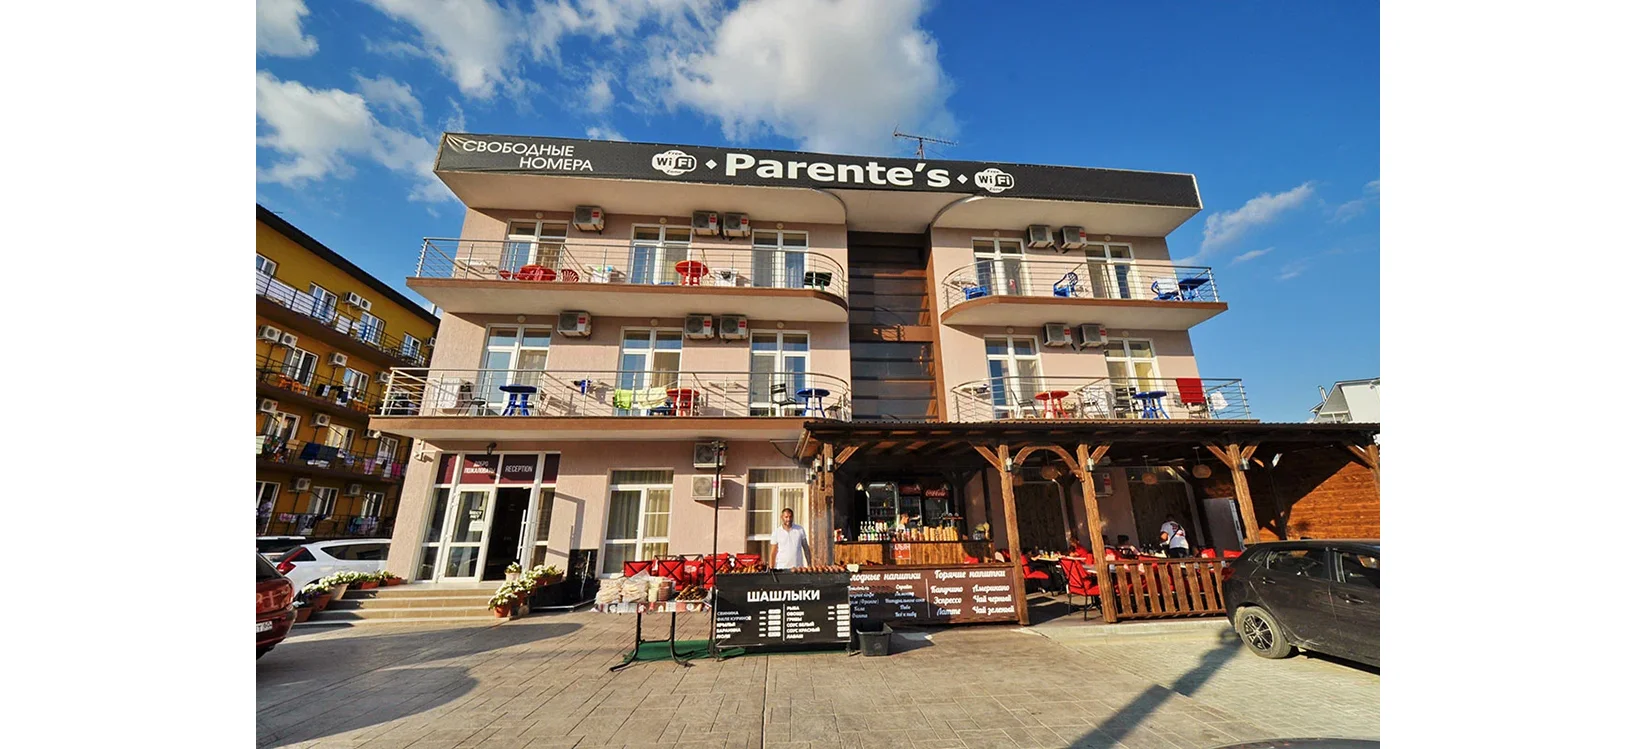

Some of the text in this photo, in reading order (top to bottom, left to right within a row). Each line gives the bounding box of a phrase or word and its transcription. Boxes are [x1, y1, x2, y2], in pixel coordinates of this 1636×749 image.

[463, 140, 574, 157] СВОБОДНЫЕ
[519, 157, 593, 172] НОМЕРА
[725, 153, 951, 188] Parente's
[504, 465, 533, 473] RECEPTION
[850, 573, 881, 583] лодные
[934, 570, 1006, 581] Горячие напитки
[930, 585, 964, 595] Капучино
[972, 584, 1010, 593] Американо
[747, 590, 820, 602] ШАШЛЫКИ
[933, 596, 963, 606] Эспрессо
[972, 594, 1012, 604] Чай черный
[936, 607, 961, 616] Латте
[972, 605, 1016, 615] Чай зеленый
